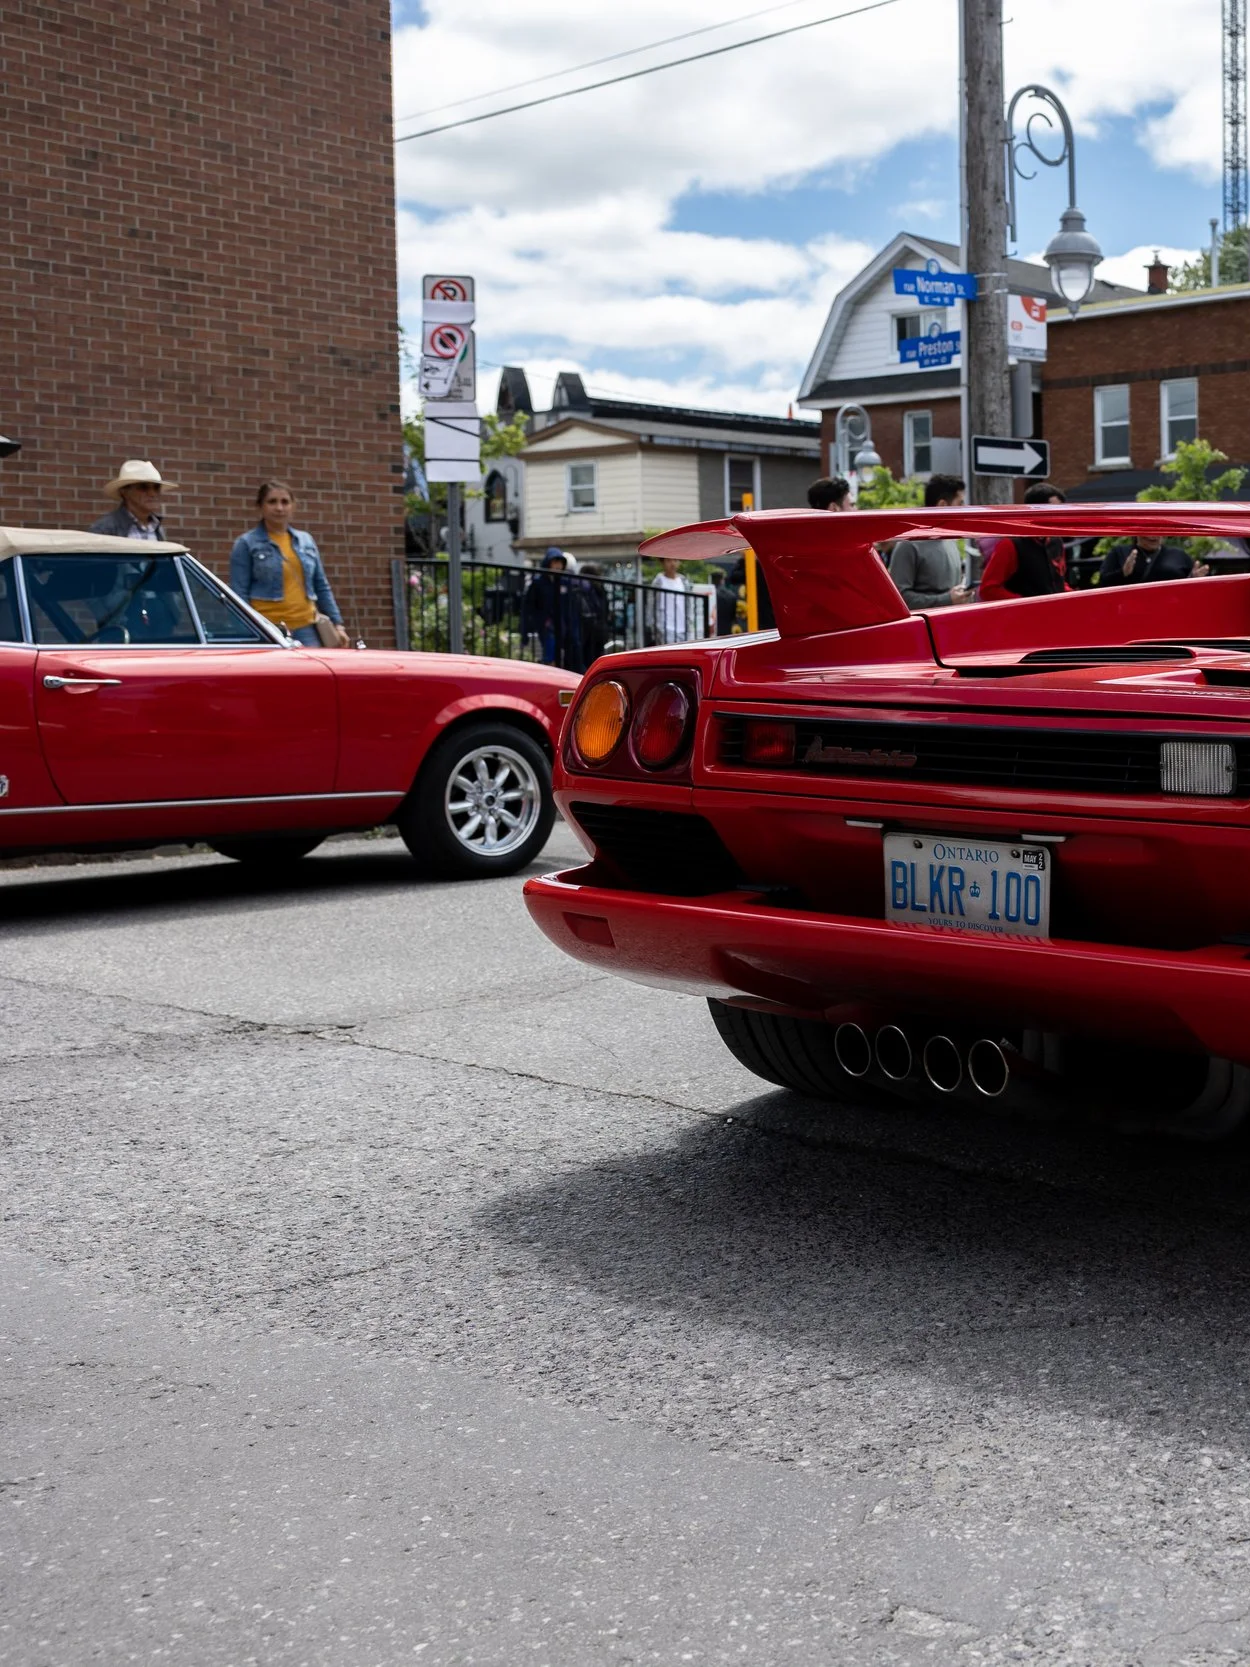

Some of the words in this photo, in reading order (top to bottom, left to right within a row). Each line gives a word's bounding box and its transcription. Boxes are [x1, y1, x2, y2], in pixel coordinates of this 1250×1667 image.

[903, 283, 915, 292] rue
[916, 276, 957, 294] Norman
[906, 350, 917, 359] rue
[918, 340, 954, 357] Preston
[934, 844, 999, 864] ONTARIO
[1024, 854, 1037, 864] MAY
[890, 860, 966, 917] BLKR
[988, 869, 1042, 927] 100
[928, 917, 953, 927] YOURS
[956, 920, 966, 929] TO
[968, 922, 1004, 934] DISCOVER
